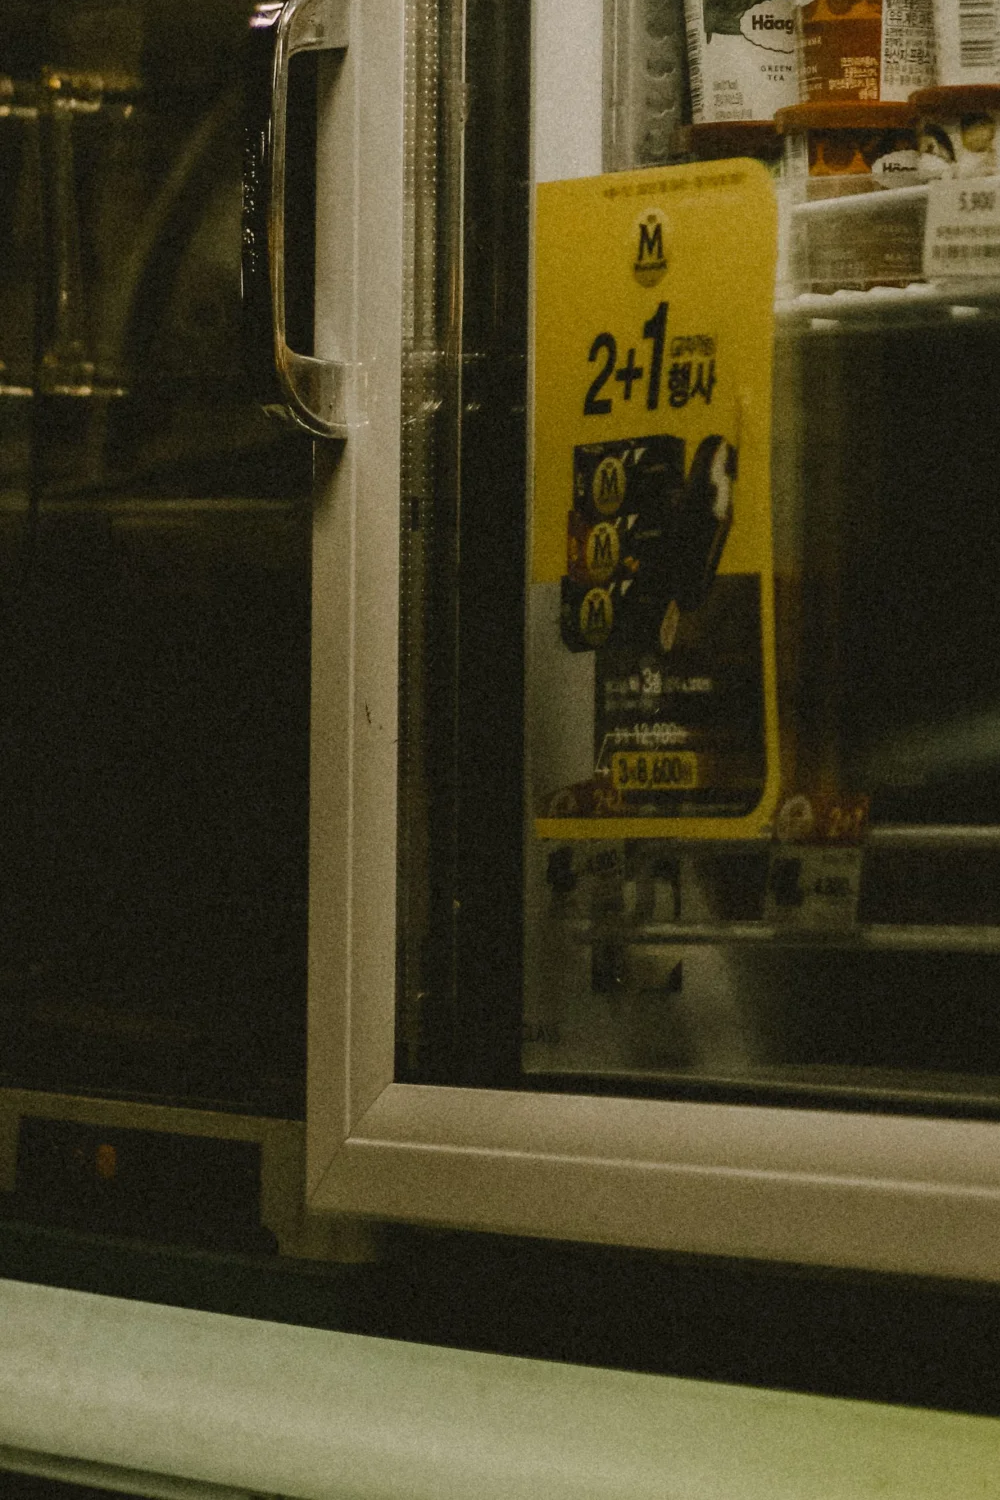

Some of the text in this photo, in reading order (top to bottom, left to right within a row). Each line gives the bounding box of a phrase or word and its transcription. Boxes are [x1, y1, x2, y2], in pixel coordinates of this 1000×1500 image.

[760, 64, 792, 73] GREEN
[767, 74, 786, 82] TEA
[583, 300, 717, 416] 2+1 행사
